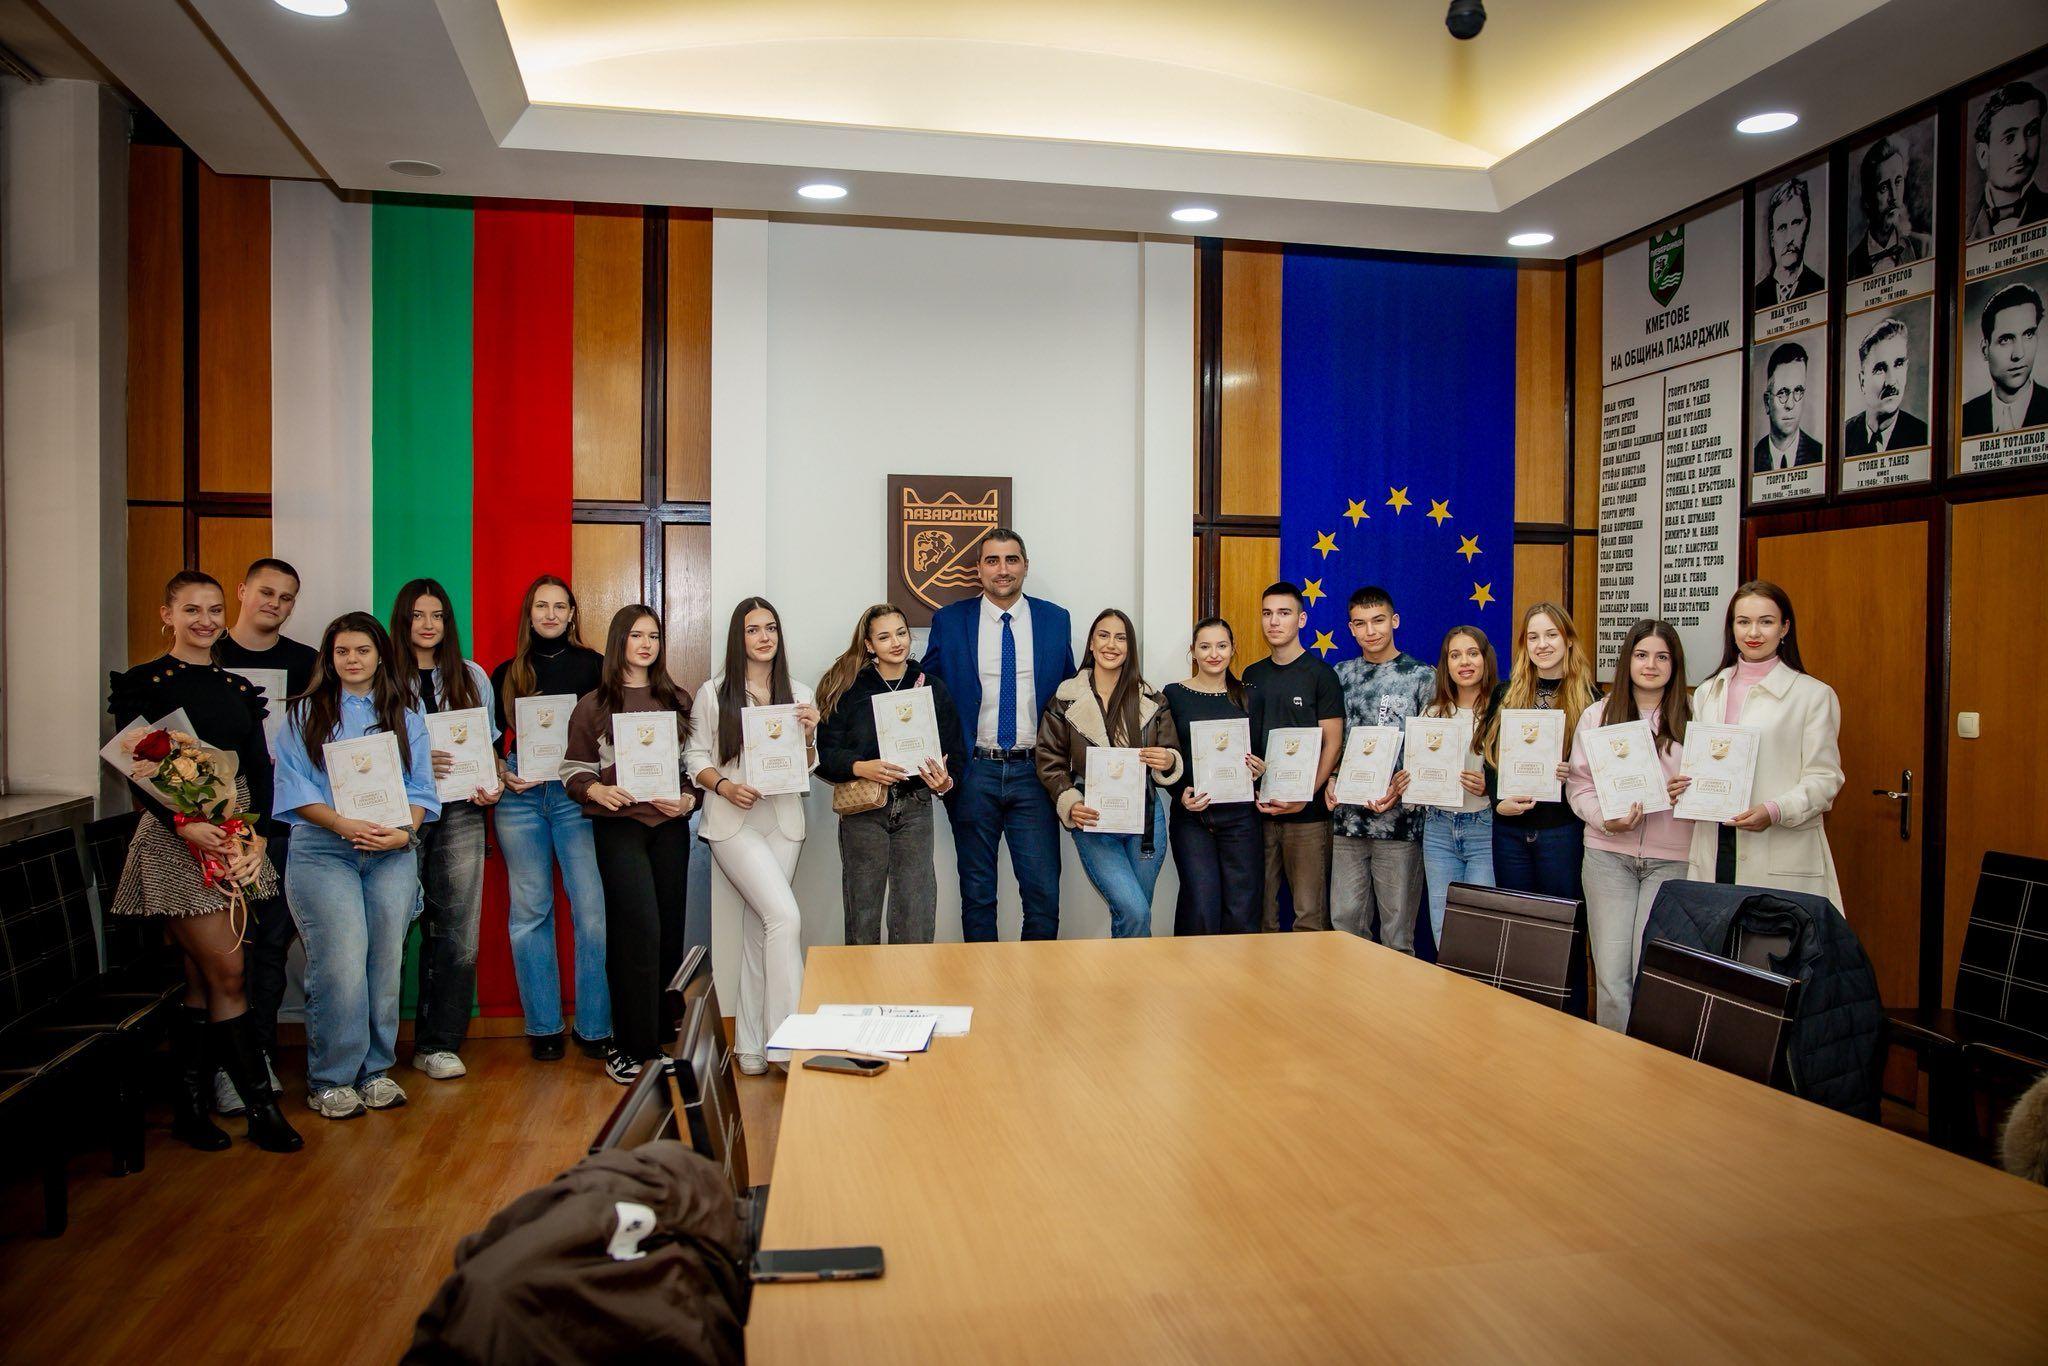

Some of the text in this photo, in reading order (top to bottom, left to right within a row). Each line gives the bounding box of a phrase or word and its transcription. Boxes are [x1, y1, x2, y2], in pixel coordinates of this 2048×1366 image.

[1989, 226, 2046, 253] ГЕОРГИ ПЕНЕВ
[1863, 269, 1912, 291] ГЕОРГИ БРЕГОВ
[1646, 305, 1690, 335] КМЕТОВЕ
[1771, 308, 1785, 320] ИВАН
[1611, 320, 1730, 371] НА ОБЩИНА ПАЗАРДЖИК
[1668, 384, 1687, 397] ГЕОРГИ
[1668, 400, 1684, 412] СТОЯН
[1693, 394, 1710, 406] ТАНЕВ
[1668, 415, 1681, 426] ИВАН
[1980, 432, 2046, 451] ИВАН ТОТЛЯКОВ
[1667, 443, 1683, 455] СТОЯН
[1667, 455, 1695, 468] ВЛАДИМИР
[1705, 448, 1732, 462] ГЕОРГИЕВ
[1858, 459, 1878, 472] СТОЯН
[1889, 455, 1910, 467] ТАНЕВ
[1766, 470, 1808, 485] ГЕОРГИ ГЪРБЕВ
[1666, 499, 1693, 511] КОСТАДИН
[904, 508, 998, 521] ПАЗАРДЖИК
[1665, 516, 1679, 526] ИВАН
[1665, 528, 1690, 540] ДИМИТЪР
[1665, 545, 1677, 555] СПАС
[1675, 557, 1694, 568] ГЕОРГИ
[1703, 555, 1724, 566] ТЕРЗОВ
[1664, 574, 1680, 584] СЛАВИ
[1690, 572, 1706, 582] ГЕНОВ
[1664, 588, 1677, 598] ИВАН
[1690, 586, 1718, 596] КОЛЧАКОВ
[1664, 602, 1709, 612] ИВАН ЕВСТАТИЕВ
